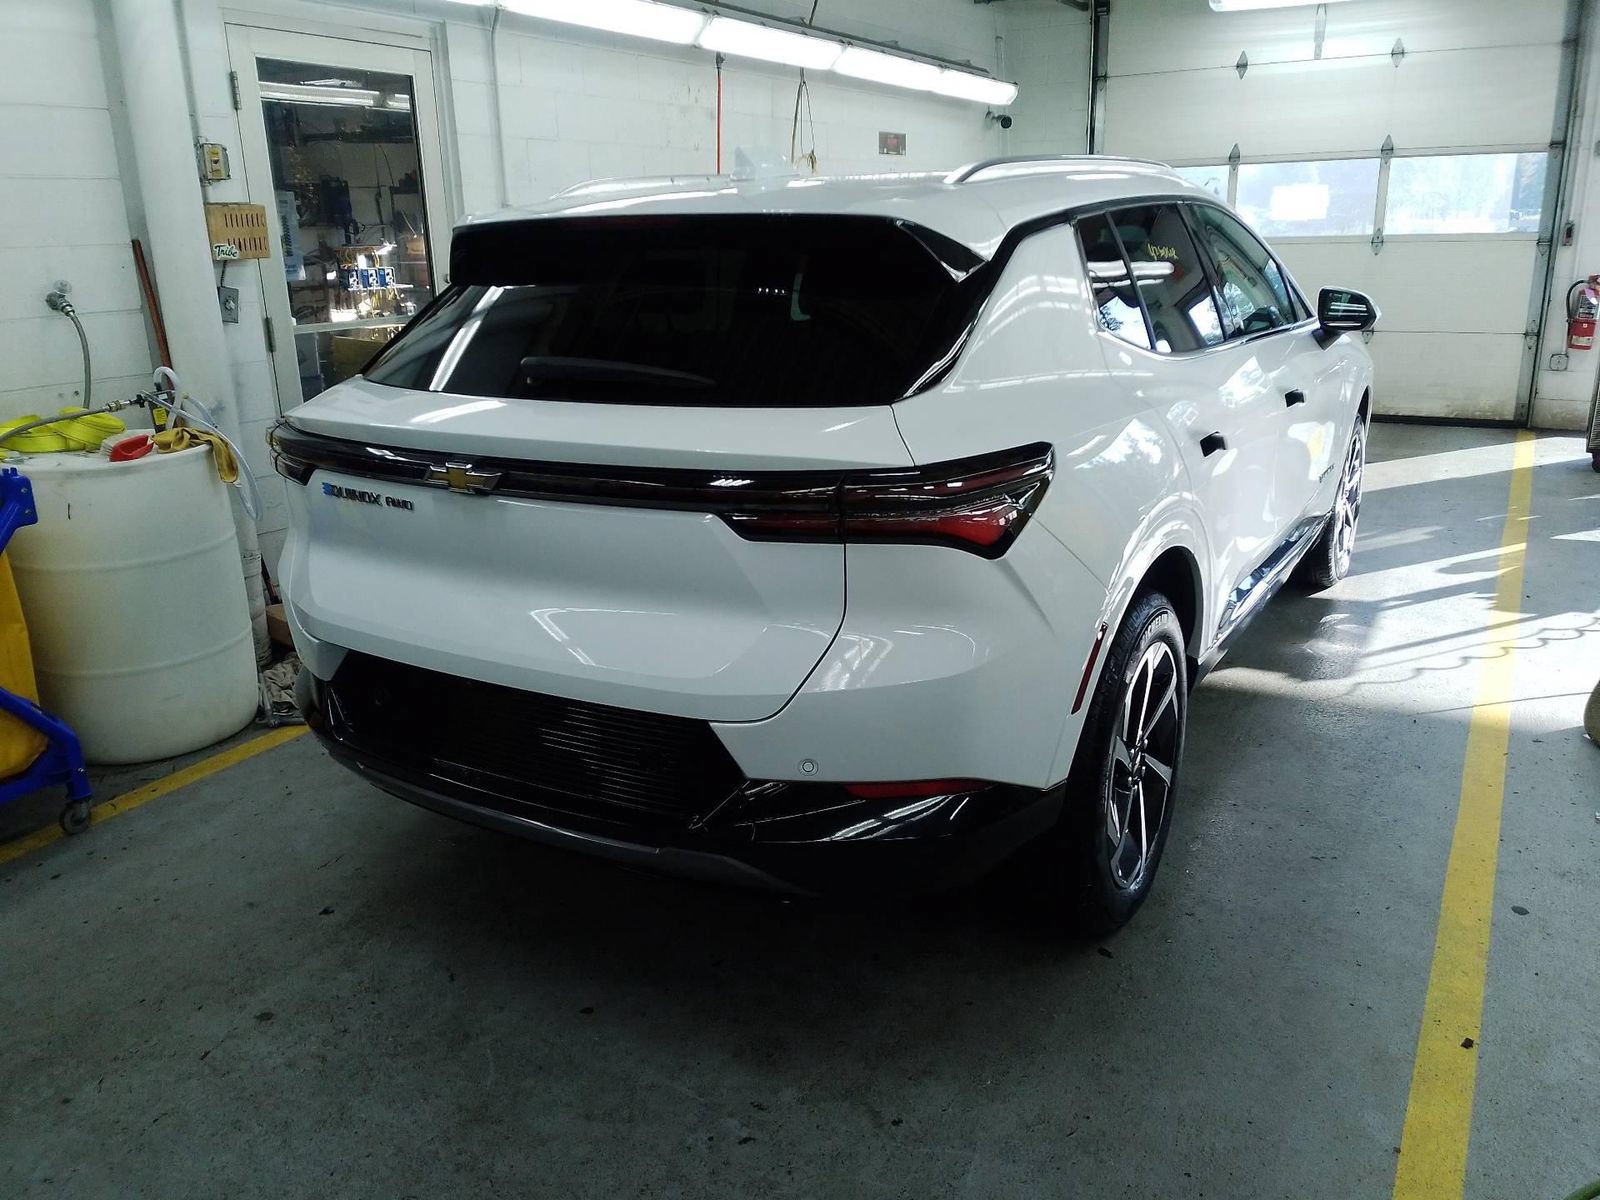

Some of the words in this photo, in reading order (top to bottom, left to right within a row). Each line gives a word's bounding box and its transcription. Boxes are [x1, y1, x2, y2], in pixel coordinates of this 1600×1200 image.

[215, 245, 237, 258] Tribe
[322, 482, 382, 506] EQUINOX
[385, 496, 414, 511] AWD
